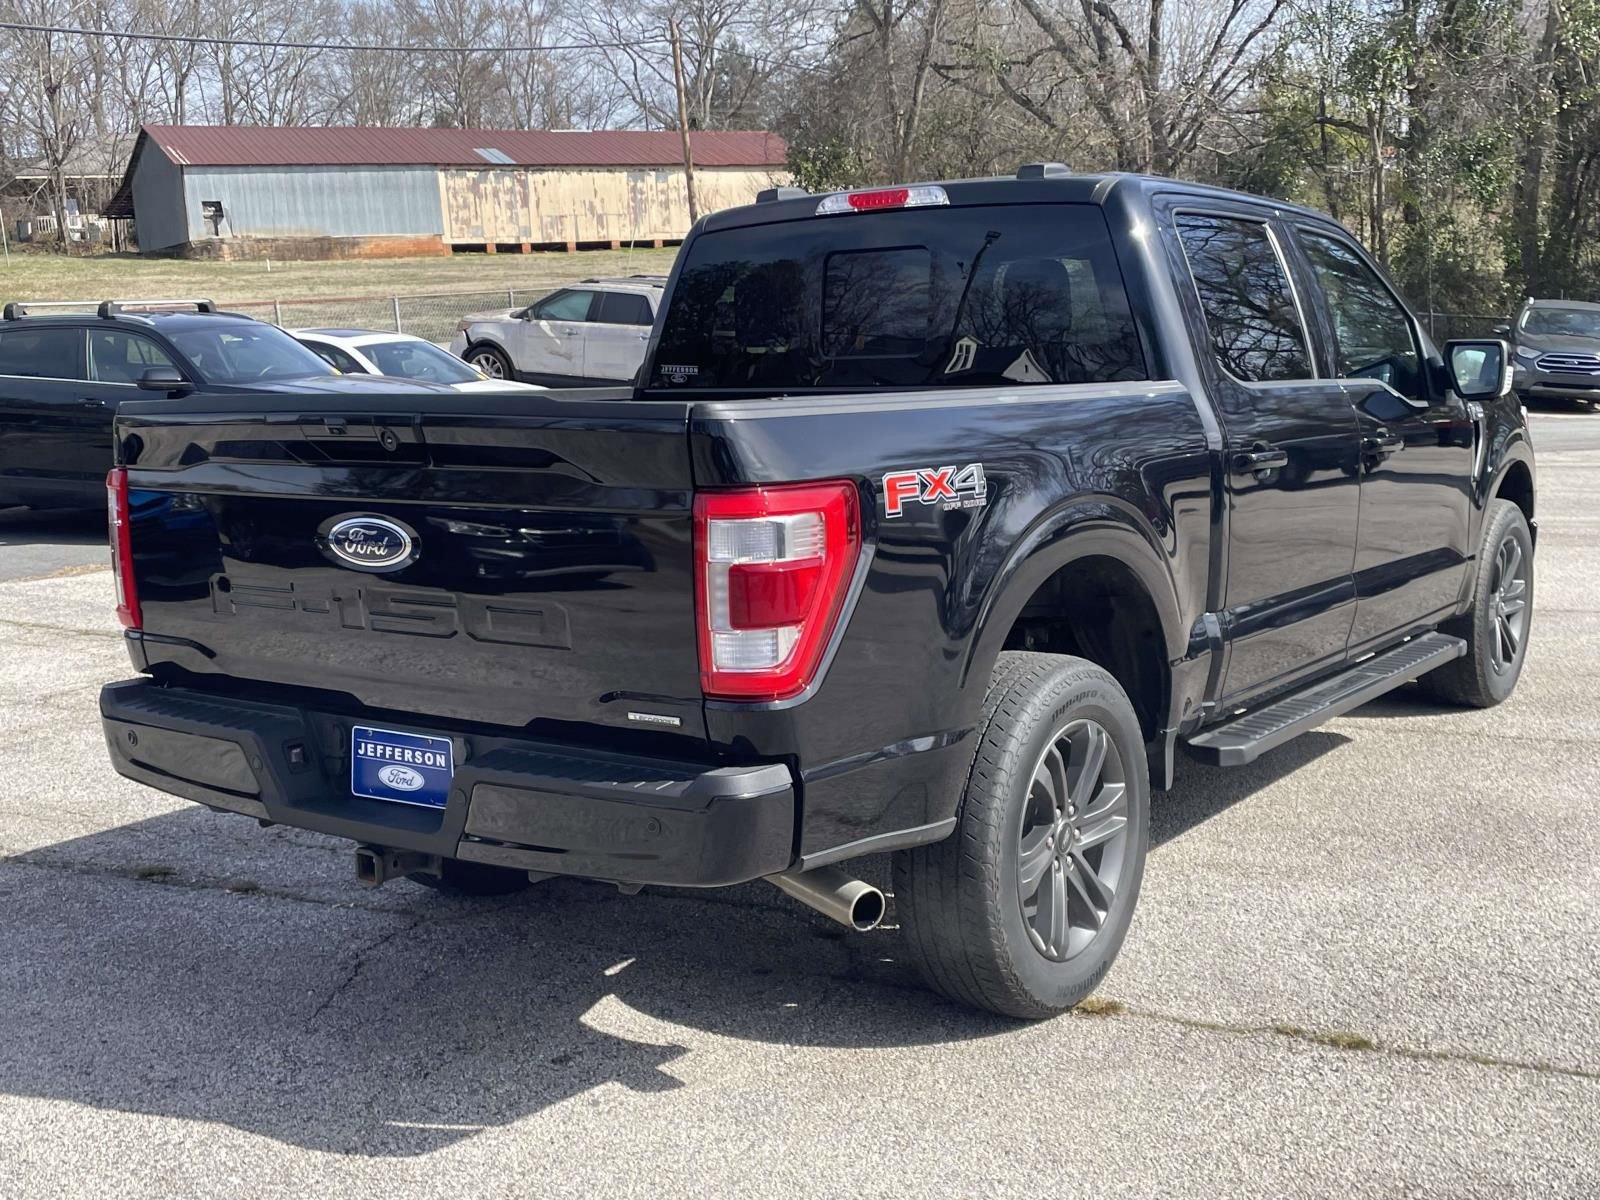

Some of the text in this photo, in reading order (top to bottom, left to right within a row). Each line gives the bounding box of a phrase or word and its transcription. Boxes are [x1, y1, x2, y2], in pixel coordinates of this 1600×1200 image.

[882, 463, 987, 518] FX4
[337, 527, 390, 556] Ford
[358, 742, 446, 767] JEFFERSON
[387, 768, 416, 787] Ford
